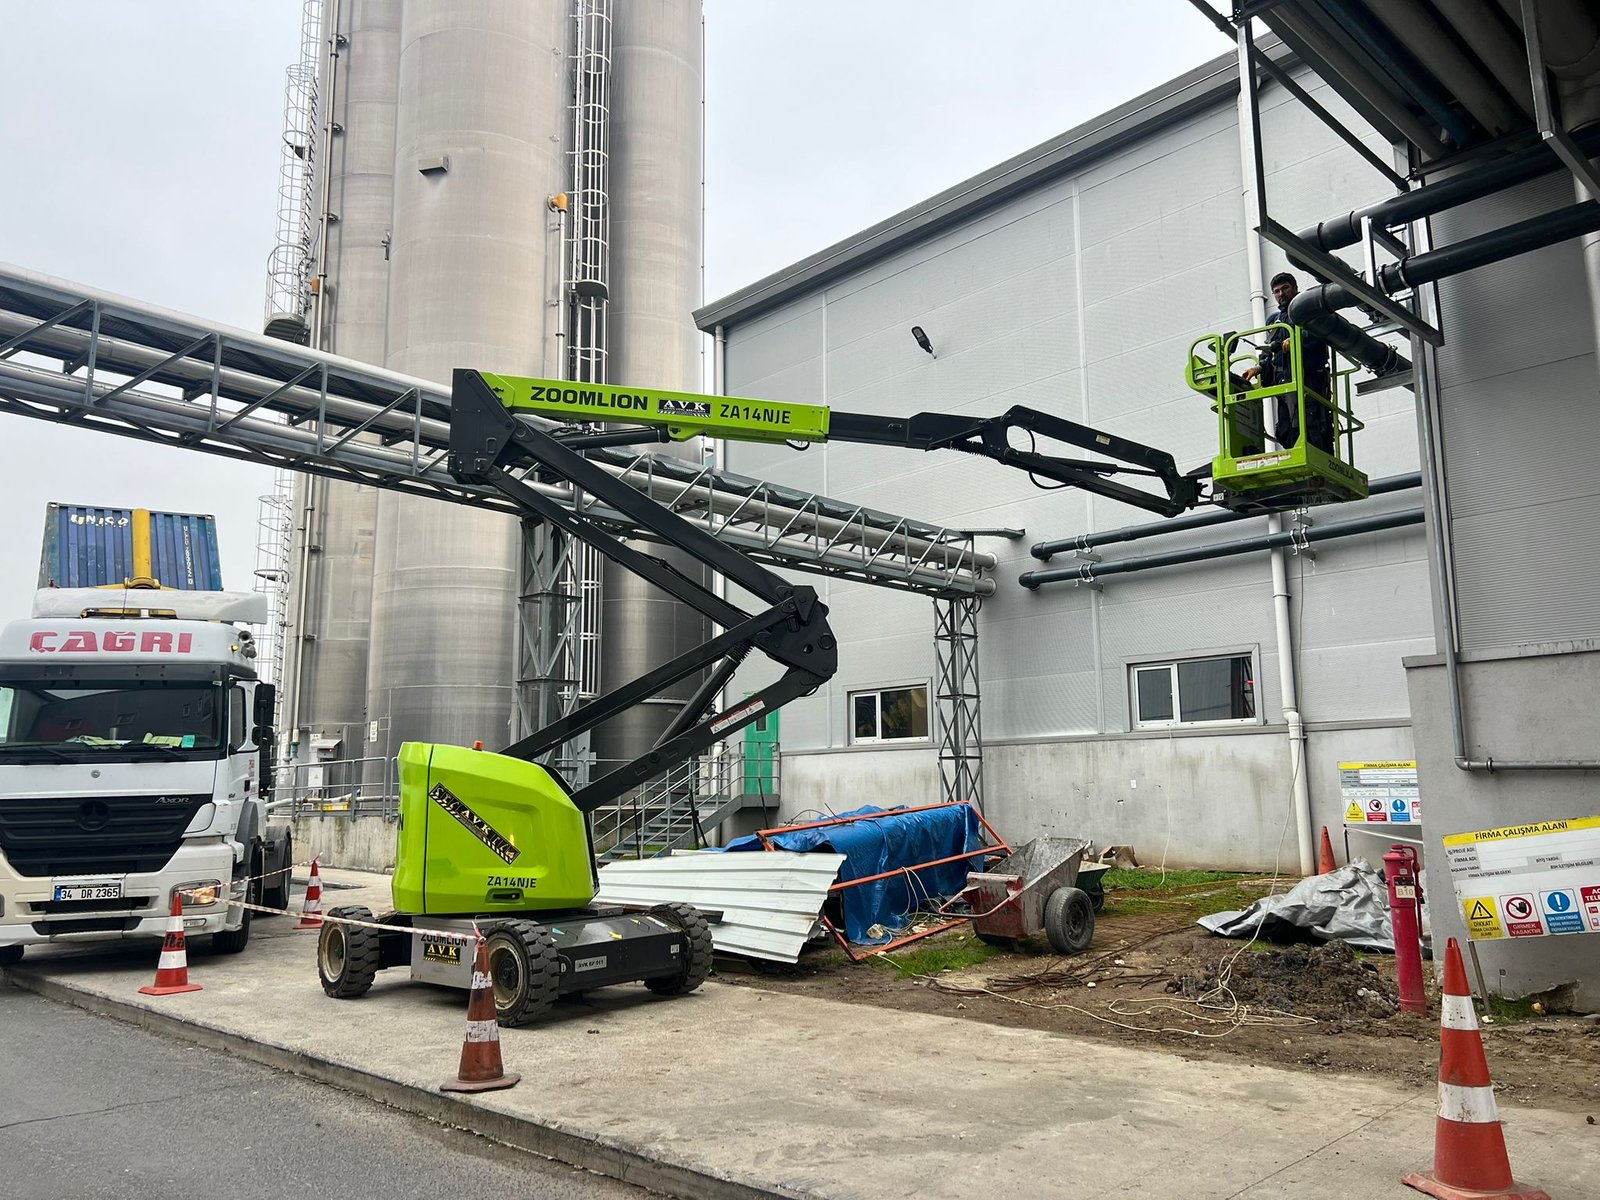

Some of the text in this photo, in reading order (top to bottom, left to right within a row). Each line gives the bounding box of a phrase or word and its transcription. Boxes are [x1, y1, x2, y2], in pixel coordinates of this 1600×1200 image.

[530, 386, 791, 424] ZOOMLION AVK ZA14NJE
[462, 809, 491, 835] AVK
[1475, 822, 1568, 840] FİRMA ÇALIŞMA ALANI
[487, 876, 537, 889] ZA14NJE
[61, 888, 118, 899] 34 DR 2365
[427, 944, 457, 956] AVK
